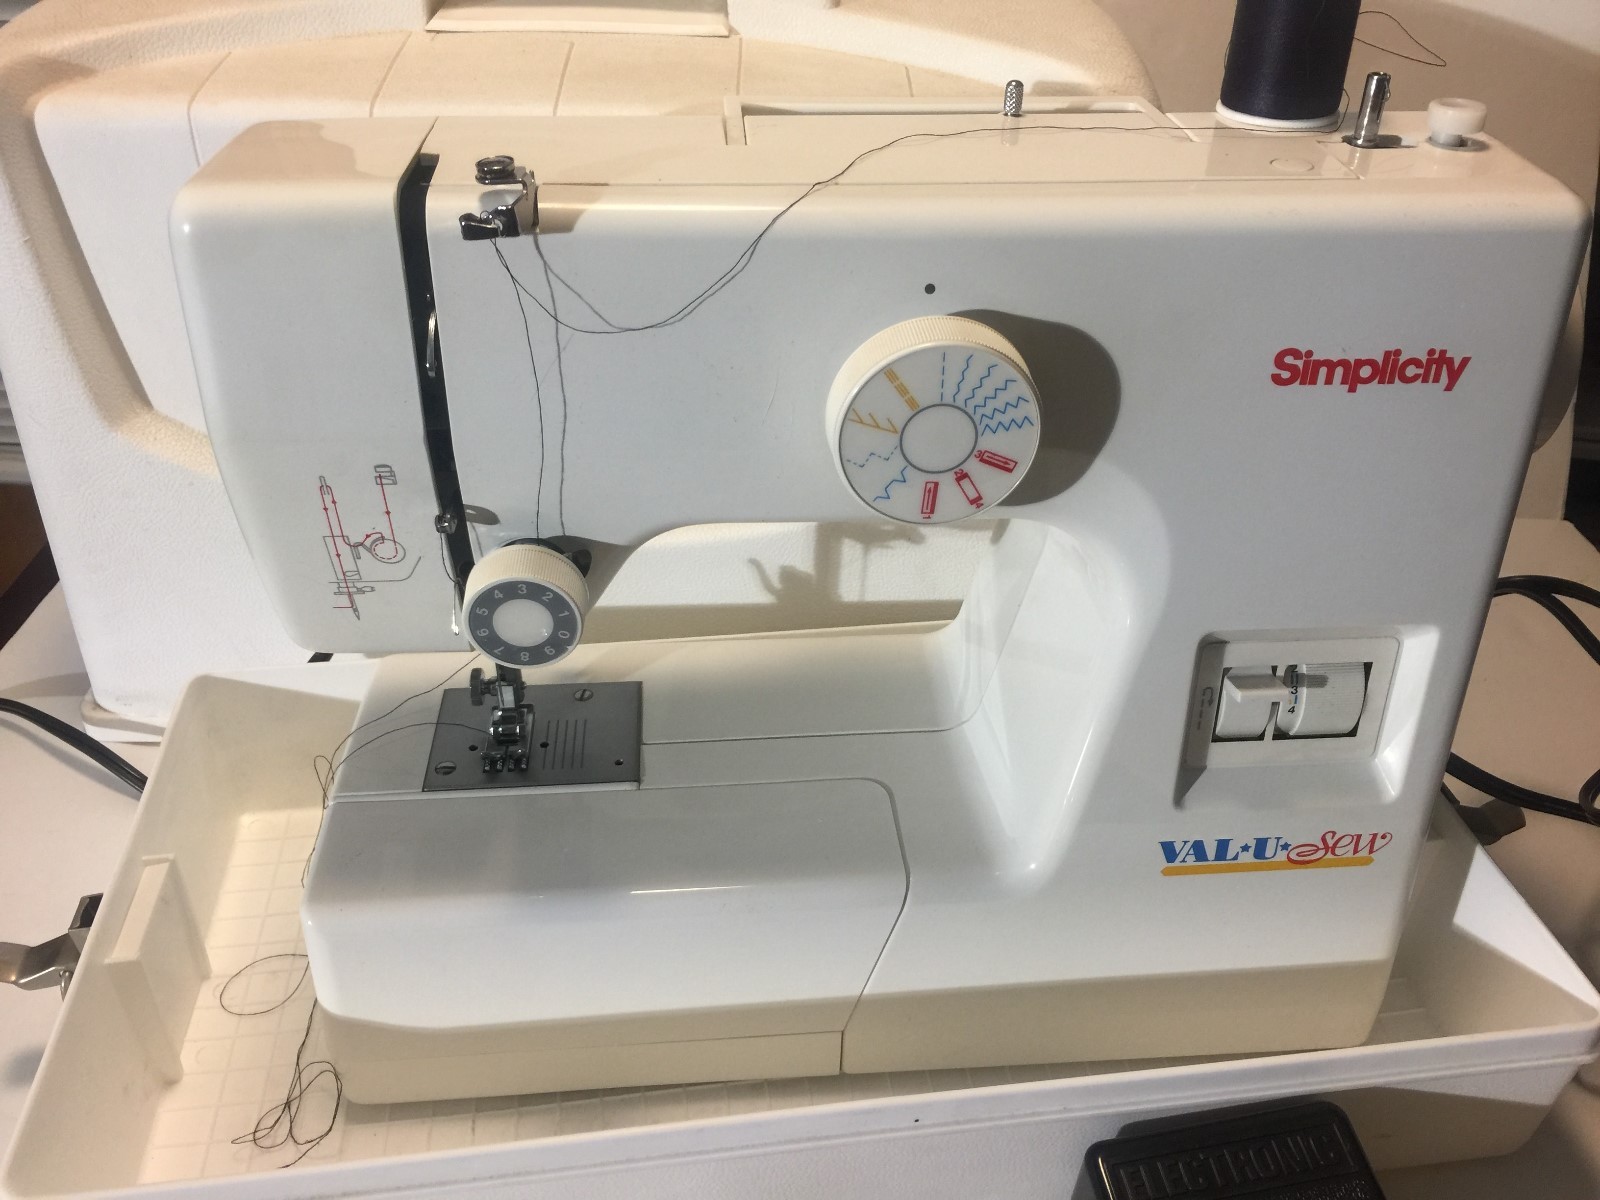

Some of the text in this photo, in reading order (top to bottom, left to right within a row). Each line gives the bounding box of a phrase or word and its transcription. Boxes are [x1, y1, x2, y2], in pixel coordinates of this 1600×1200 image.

[1270, 347, 1472, 393] Simplicity
[518, 583, 527, 594] 3
[494, 589, 504, 599] 4
[542, 591, 553, 602] 2
[475, 606, 488, 616] 5
[477, 628, 489, 637] 6
[558, 630, 570, 639] 0
[494, 646, 505, 655] 7
[544, 645, 555, 655] 9
[520, 651, 530, 661] 8
[1290, 685, 1298, 695] 3
[1287, 705, 1296, 714] 4
[1119, 1134, 1337, 1200] ELECTRONIC
